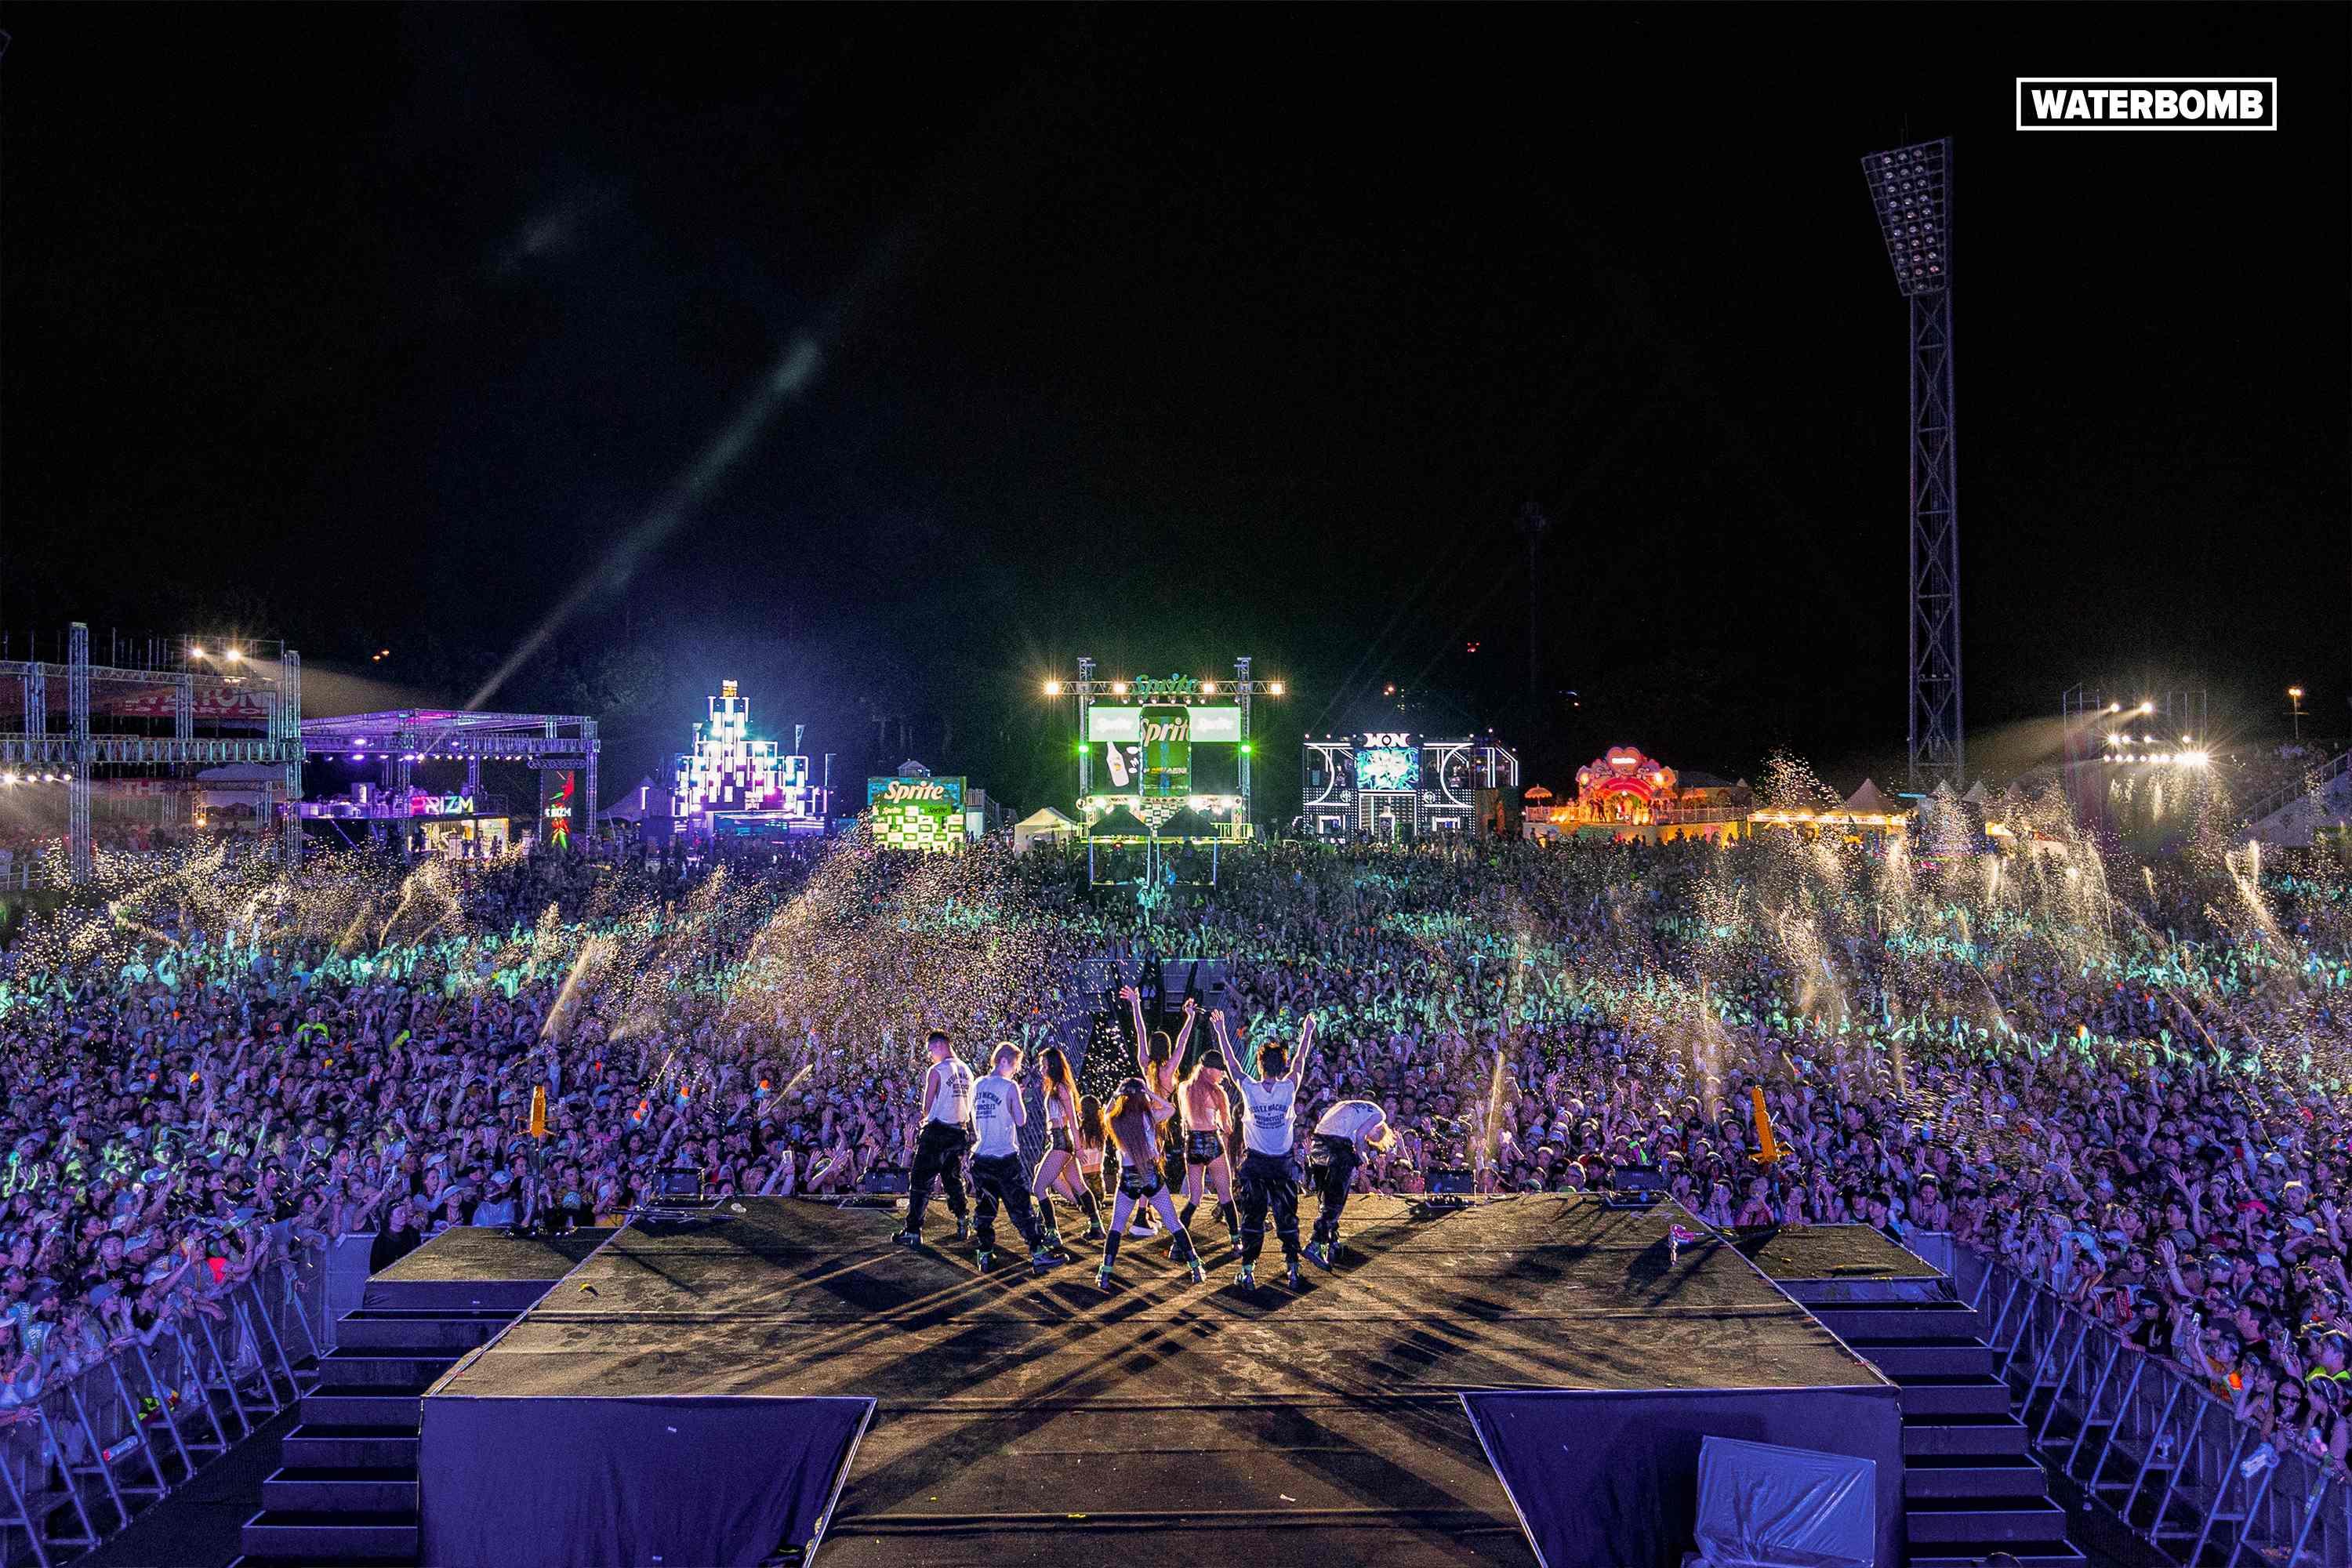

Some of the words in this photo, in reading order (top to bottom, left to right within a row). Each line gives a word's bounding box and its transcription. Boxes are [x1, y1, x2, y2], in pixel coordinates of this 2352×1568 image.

[1131, 673, 1200, 700] Sprite
[884, 780, 945, 804] Sprite
[410, 795, 474, 815] PRIZM
